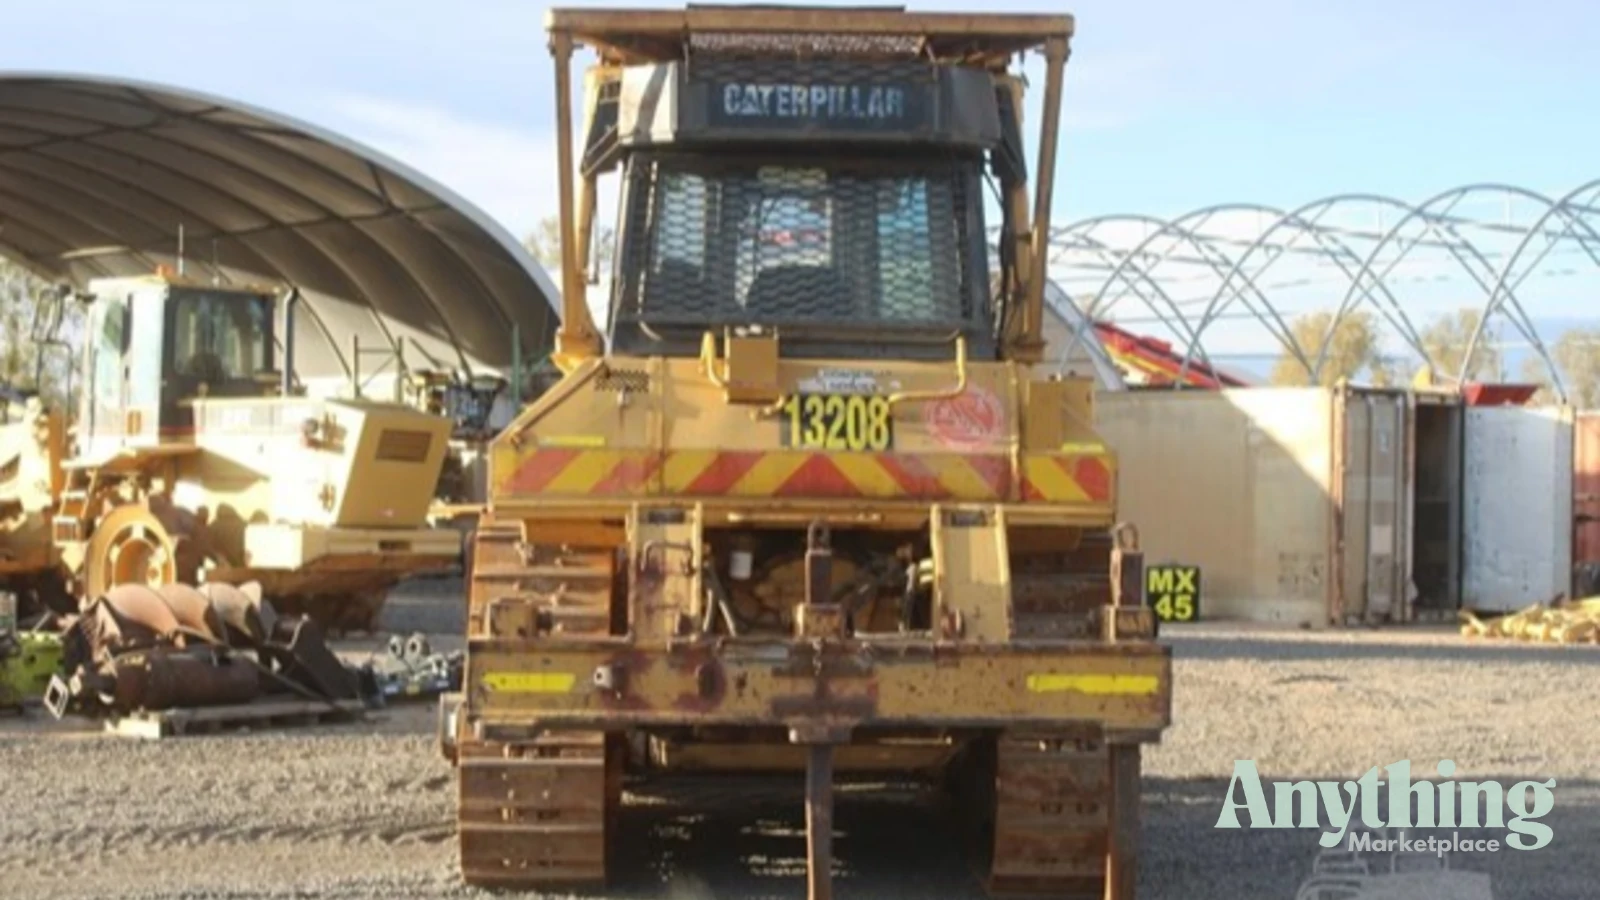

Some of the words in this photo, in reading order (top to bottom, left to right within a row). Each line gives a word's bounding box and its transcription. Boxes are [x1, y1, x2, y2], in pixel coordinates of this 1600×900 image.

[723, 83, 904, 117] CATERPILLAR
[785, 394, 889, 449] 13208
[1148, 568, 1197, 593] MX
[1155, 594, 1193, 620] 45
